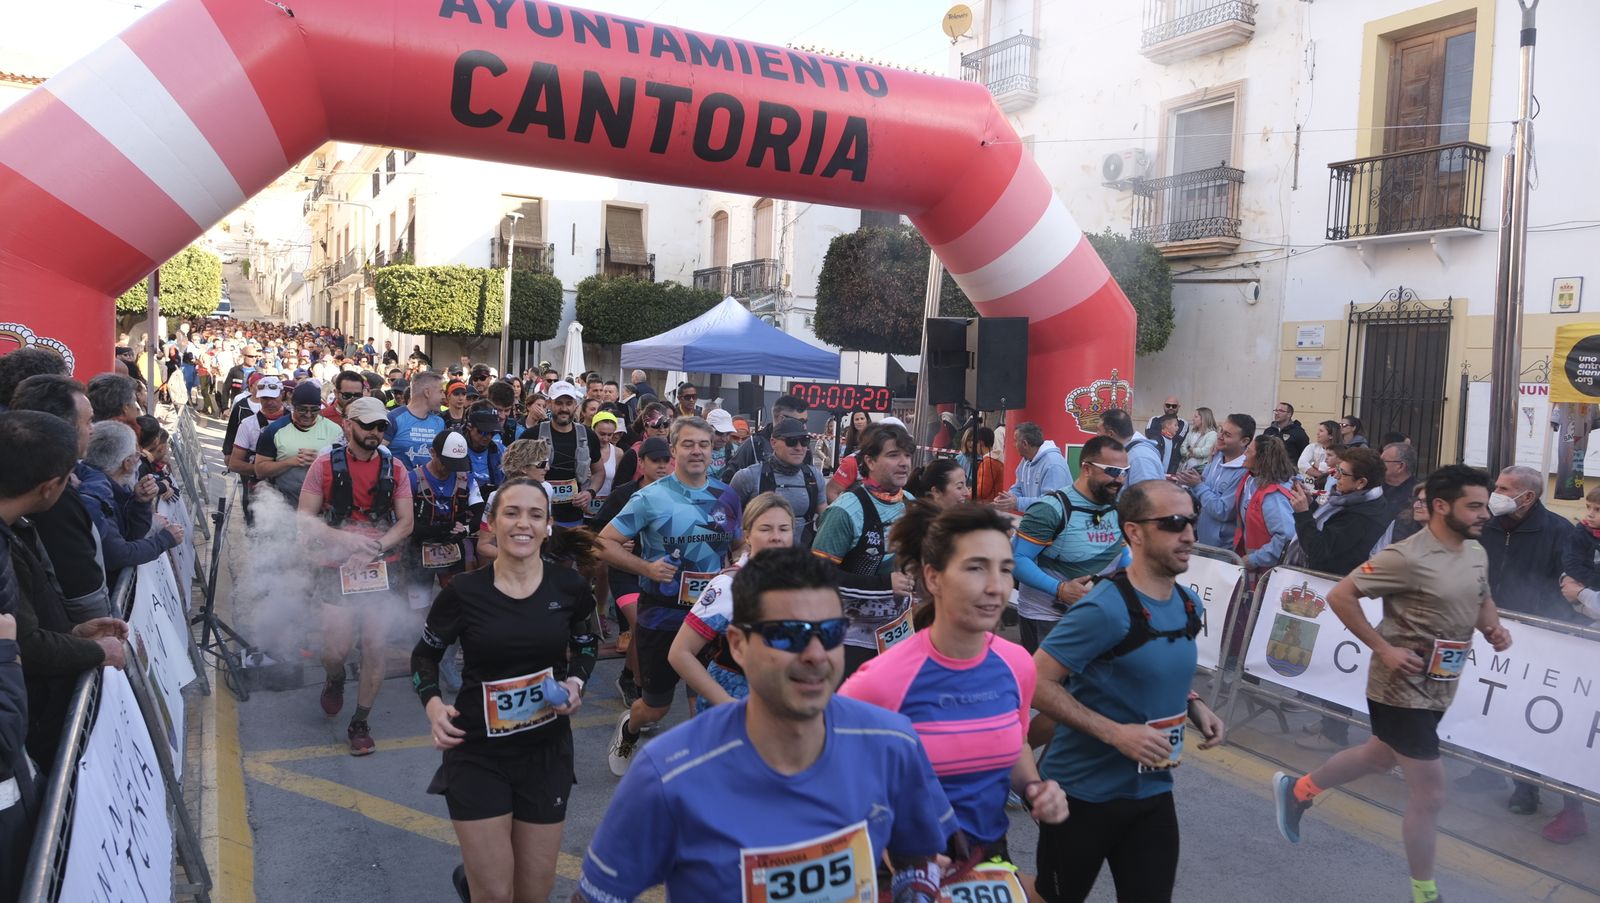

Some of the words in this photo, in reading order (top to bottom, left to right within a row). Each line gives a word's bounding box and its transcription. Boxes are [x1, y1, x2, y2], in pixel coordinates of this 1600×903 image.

[439, 0, 889, 98] AYUNTAMIENTO
[450, 49, 869, 183] CANTORIA
[1575, 376, 1594, 386] .org
[791, 383, 889, 411] 00:00:20
[552, 485, 573, 495] 163
[1087, 531, 1116, 544] VIDA
[350, 569, 379, 581] 113
[884, 620, 910, 644] 332
[498, 684, 544, 712] 375
[769, 855, 851, 900] 305
[952, 885, 1010, 903] 360
